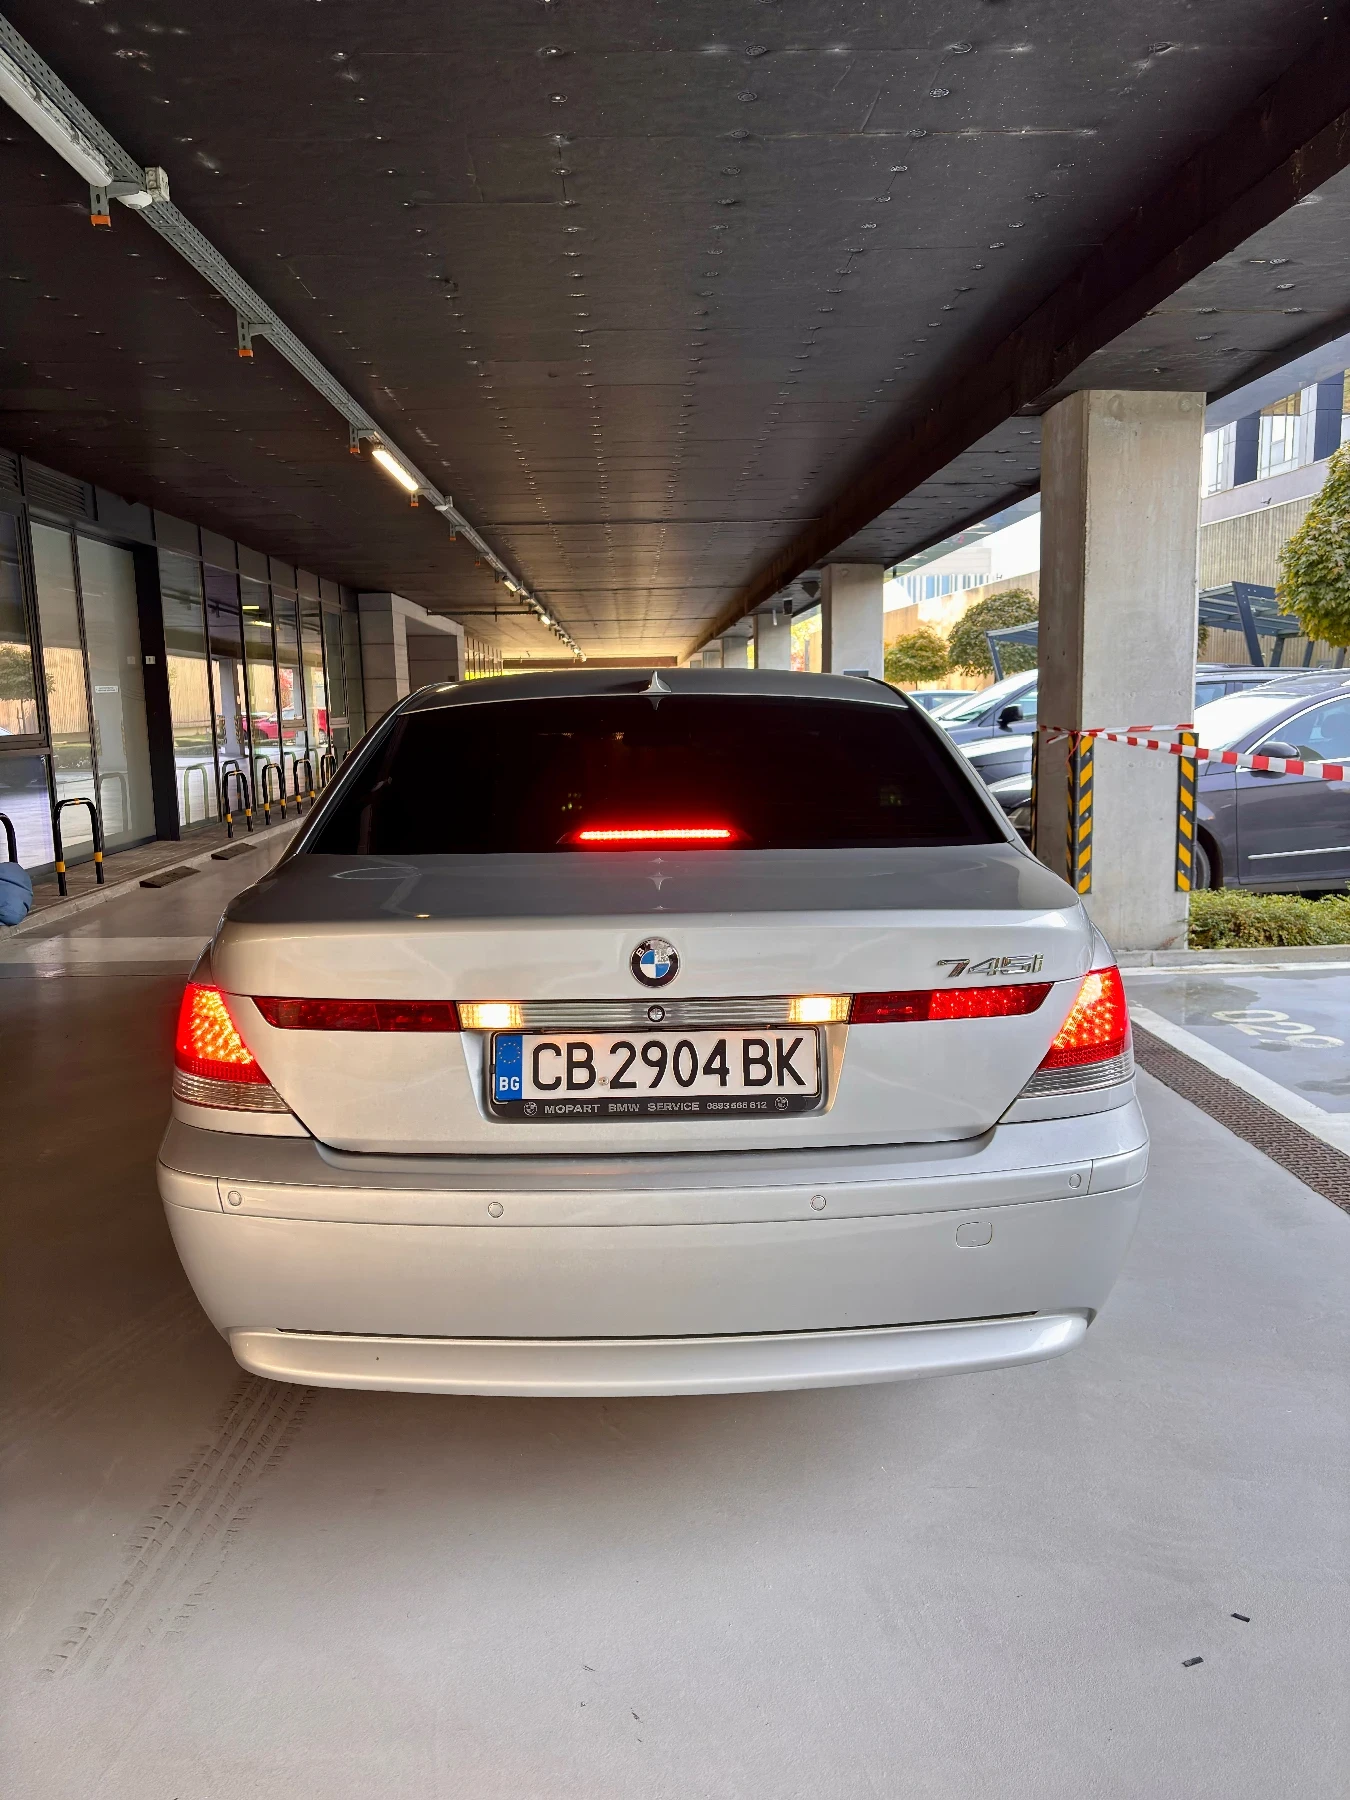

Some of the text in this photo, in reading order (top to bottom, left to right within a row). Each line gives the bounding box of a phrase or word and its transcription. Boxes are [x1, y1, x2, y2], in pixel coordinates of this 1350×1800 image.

[936, 953, 1044, 978] 745i
[531, 1037, 807, 1091] CB 2904 BK
[499, 1076, 520, 1091] BG
[544, 1103, 601, 1114] MOPART
[608, 1102, 641, 1112] BMW
[647, 1101, 700, 1111] SERVICE
